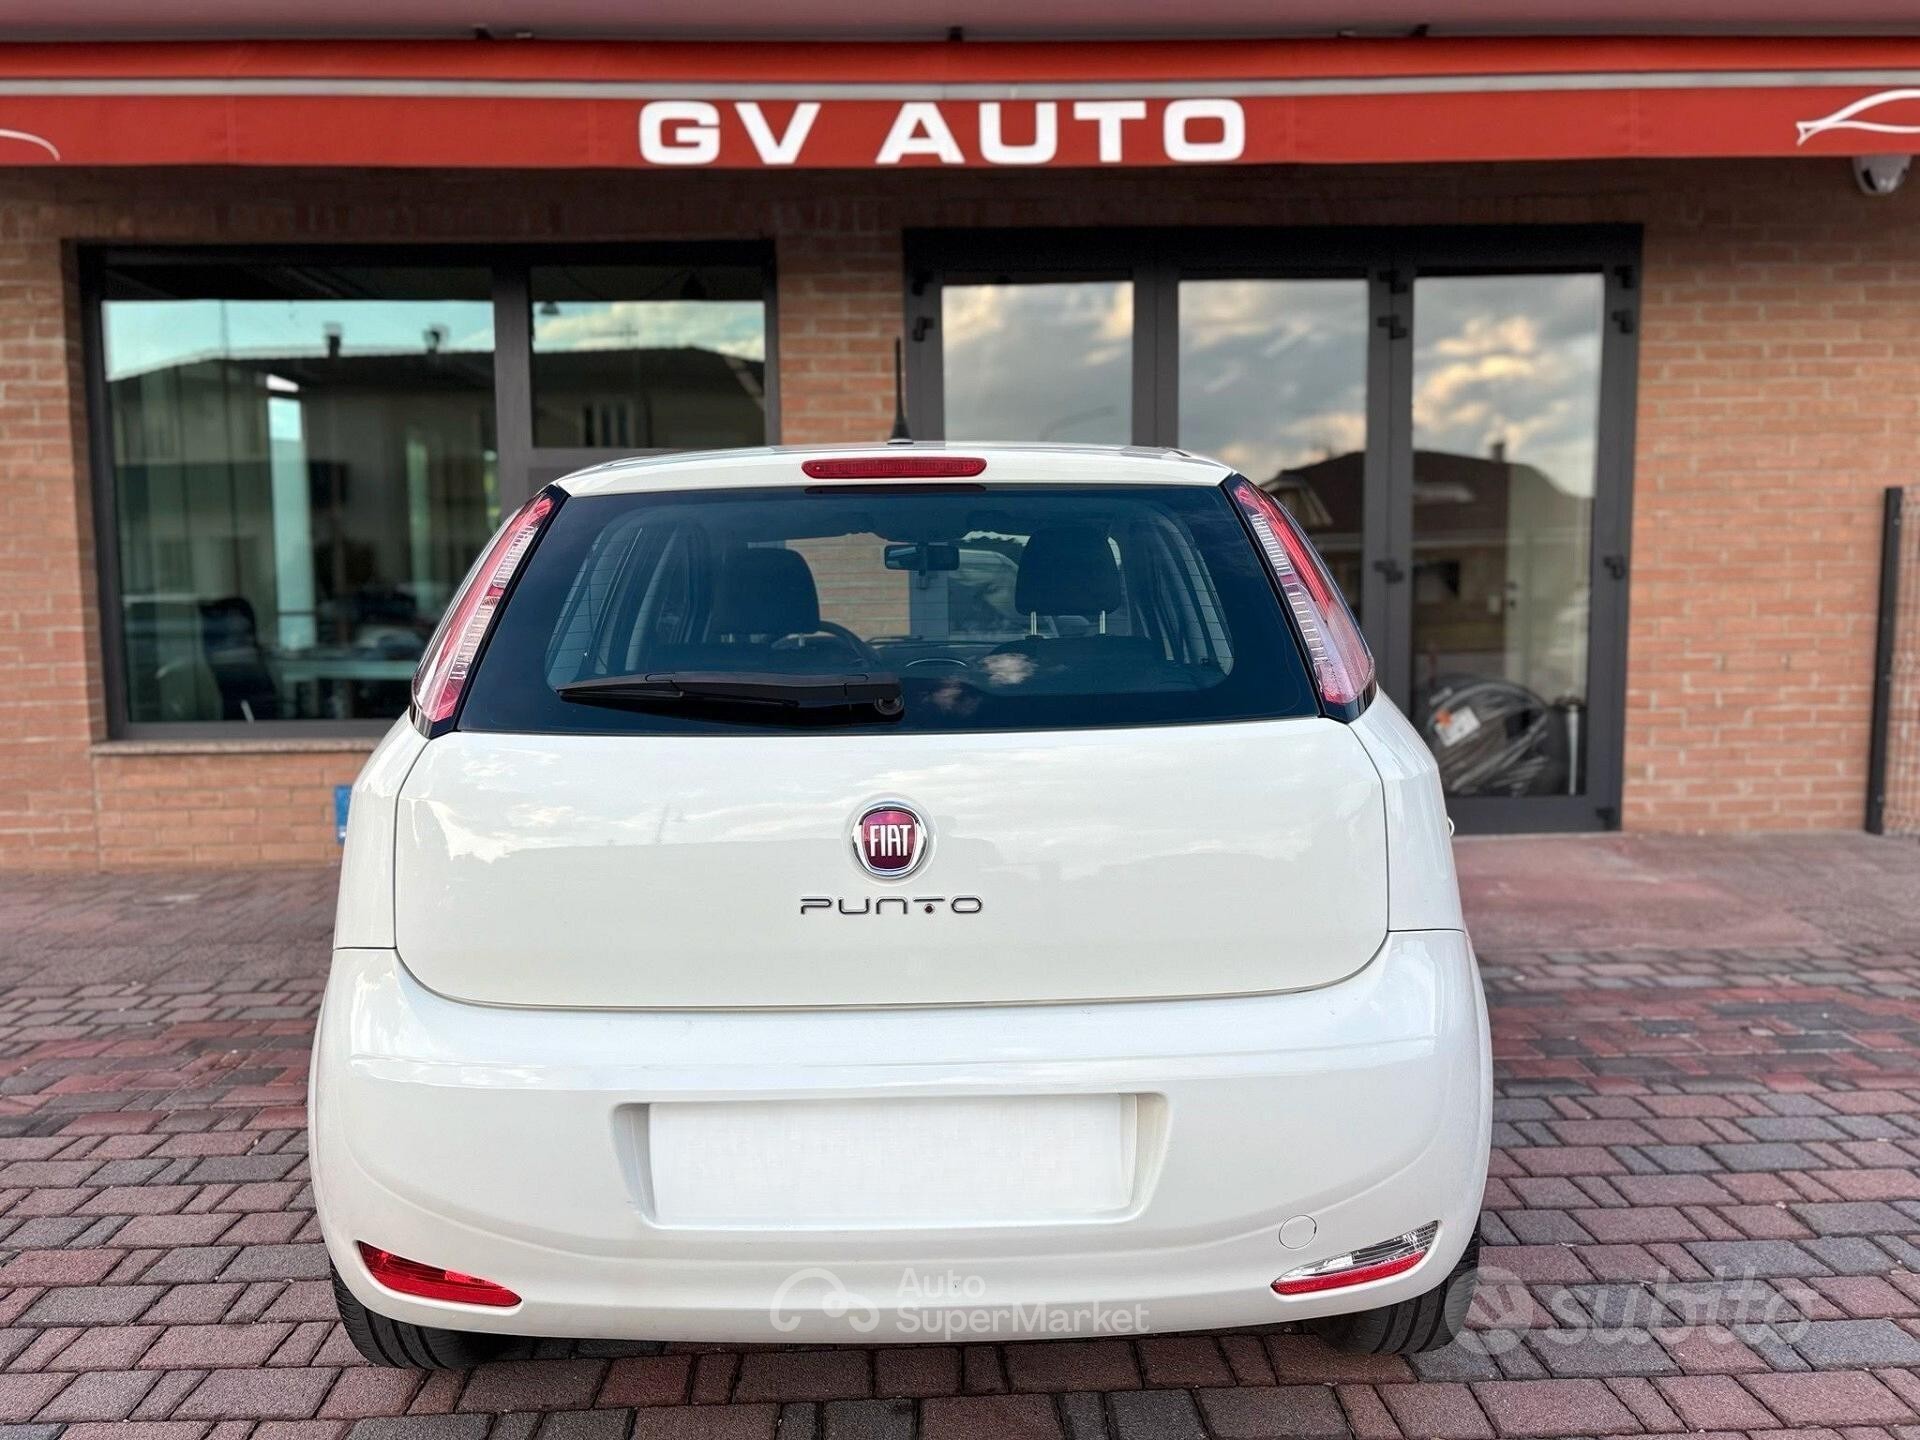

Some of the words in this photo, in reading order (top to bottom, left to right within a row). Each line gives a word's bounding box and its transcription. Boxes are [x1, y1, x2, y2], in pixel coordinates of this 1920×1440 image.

[639, 101, 821, 165] GV
[875, 99, 1246, 164] AUTO
[870, 824, 912, 857] FIAT
[800, 896, 983, 915] PUNTO
